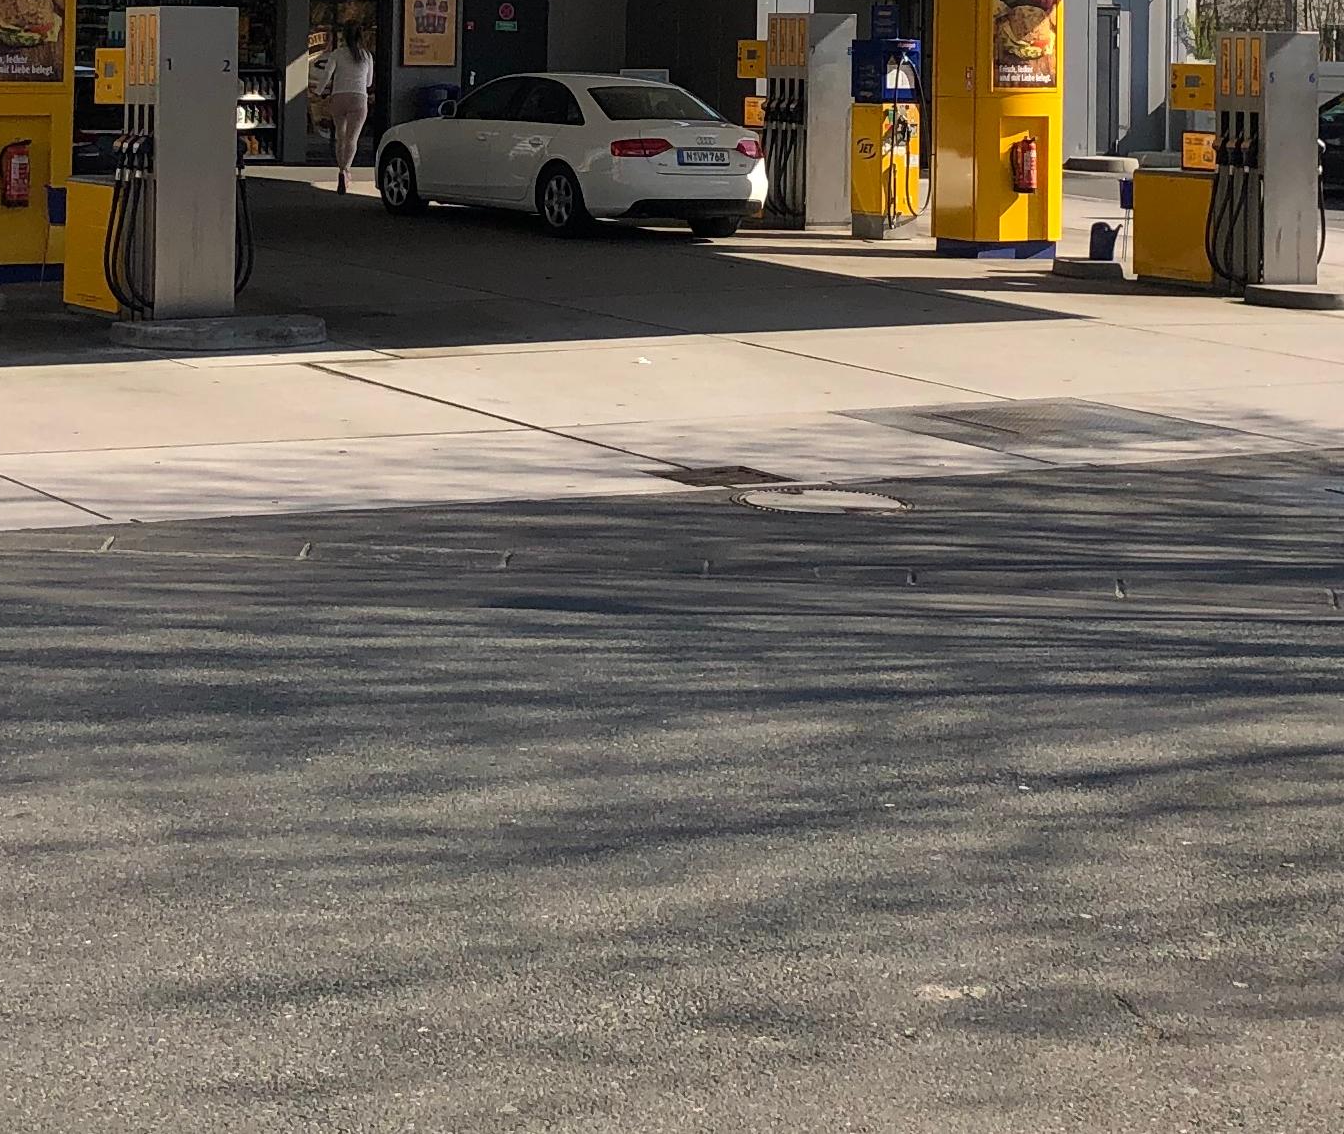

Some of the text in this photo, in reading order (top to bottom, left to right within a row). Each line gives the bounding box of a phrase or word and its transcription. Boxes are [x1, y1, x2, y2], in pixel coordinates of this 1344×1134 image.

[166, 58, 172, 70] 1
[222, 59, 231, 72] 2
[1268, 71, 1275, 83] 5
[1309, 73, 1316, 83] 6
[859, 142, 873, 154] JET
